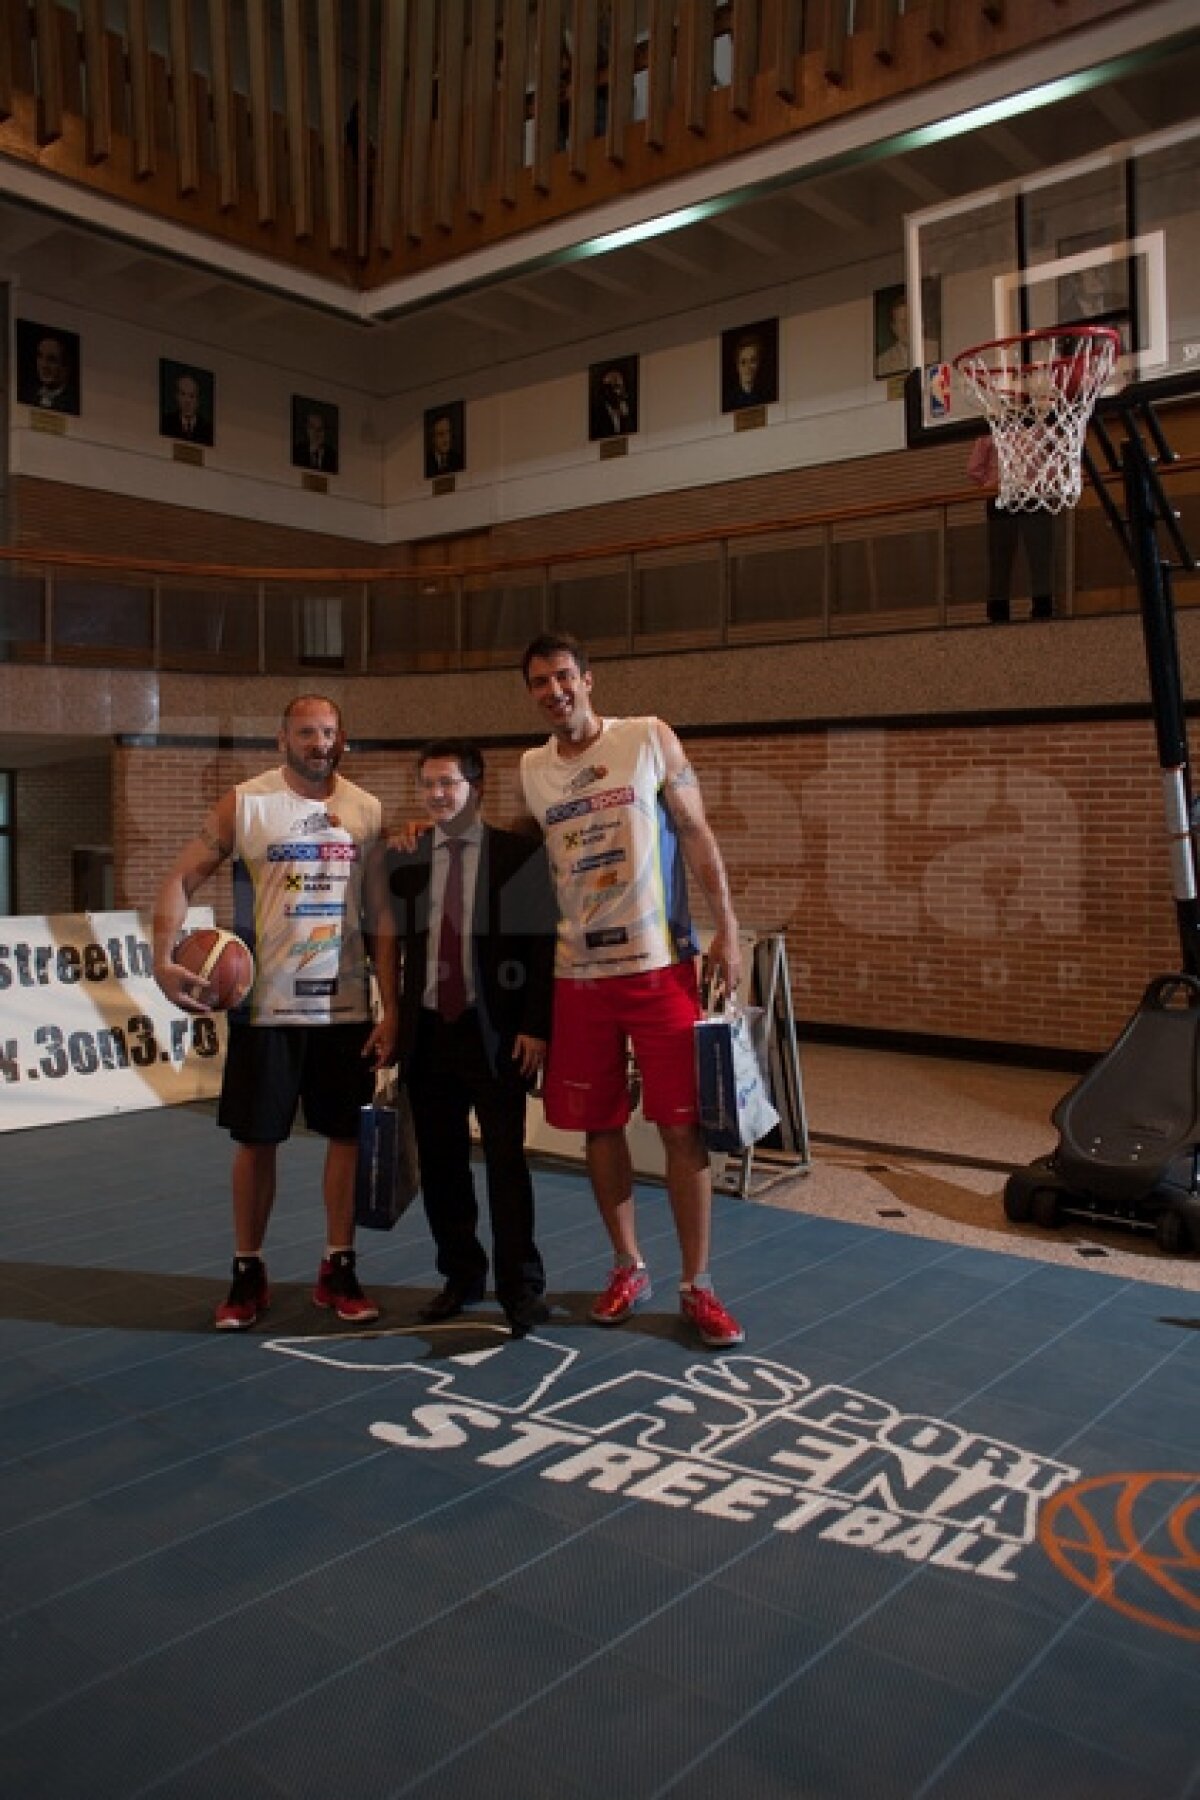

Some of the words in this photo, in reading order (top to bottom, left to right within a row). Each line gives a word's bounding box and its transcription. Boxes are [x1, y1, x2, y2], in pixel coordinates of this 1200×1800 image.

[260, 1322, 1037, 1544] ARENA
[369, 1403, 1022, 1581] STREETBALL
[685, 1356, 1081, 1497] SPORT
